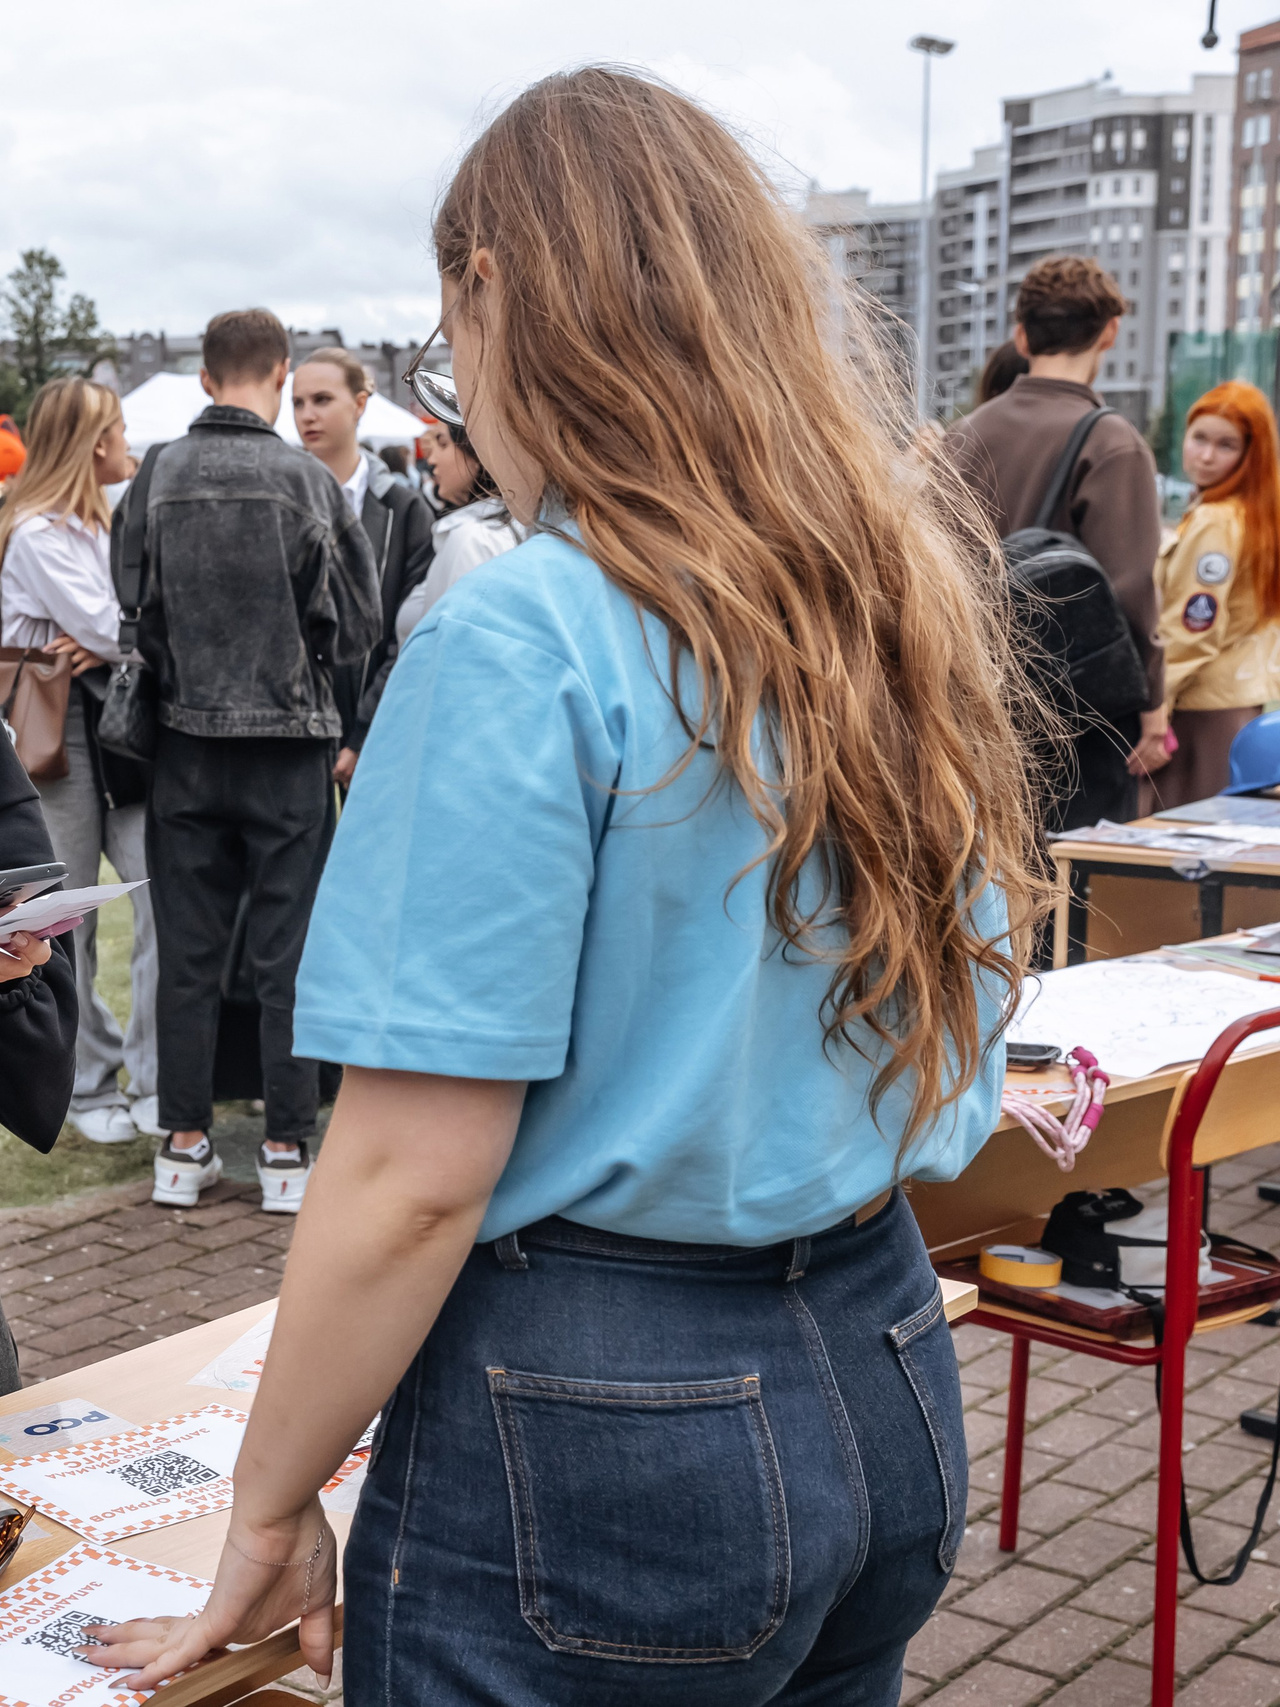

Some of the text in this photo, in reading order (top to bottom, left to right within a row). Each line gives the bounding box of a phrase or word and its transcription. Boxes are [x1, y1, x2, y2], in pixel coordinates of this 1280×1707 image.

[23, 1410, 110, 1436] РСО
[44, 1427, 211, 1480] ЗАПАДНОГО ФИЛИАЛА
[63, 1436, 169, 1469] РАНХИГС
[89, 1497, 171, 1523] ОТРЯДОВ
[26, 1581, 104, 1626] ЗАПАДНОГО
[48, 1667, 120, 1707] ОТРЯДОВ
